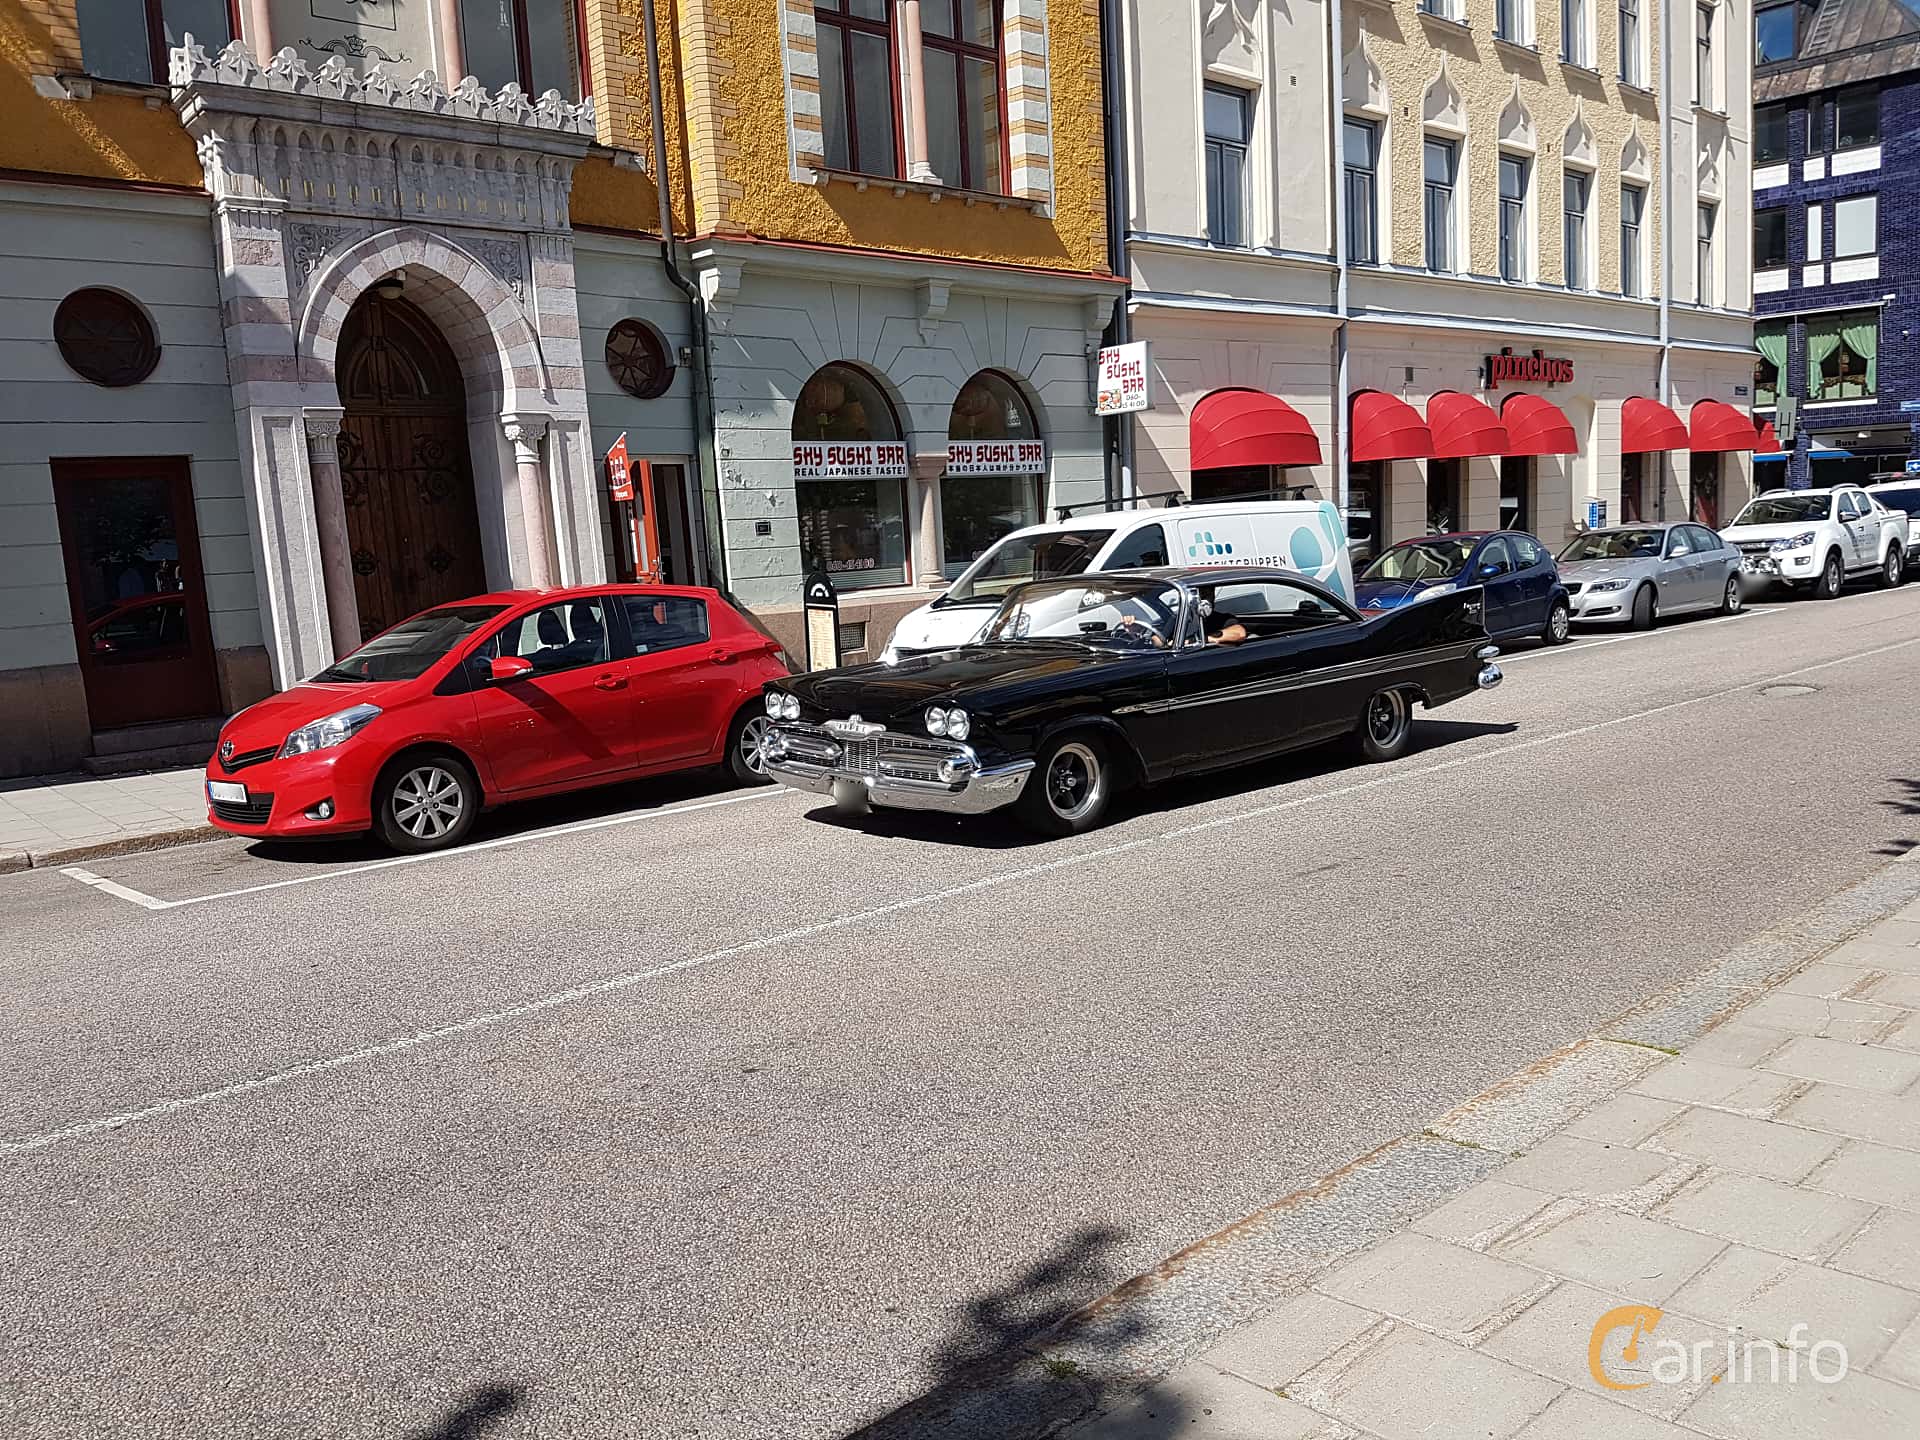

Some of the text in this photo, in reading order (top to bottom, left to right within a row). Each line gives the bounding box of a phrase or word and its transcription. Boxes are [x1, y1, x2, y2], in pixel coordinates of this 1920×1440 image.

[1107, 360, 1140, 379] SUSHI
[1488, 347, 1574, 389] pinchos
[1123, 377, 1144, 393] BAR
[828, 446, 873, 465] SUSHI
[877, 446, 904, 464] BAR
[976, 445, 1015, 462] SUSHI
[1018, 444, 1042, 462] BAR
[795, 467, 906, 476] REAL JAPANESE TASTE!
